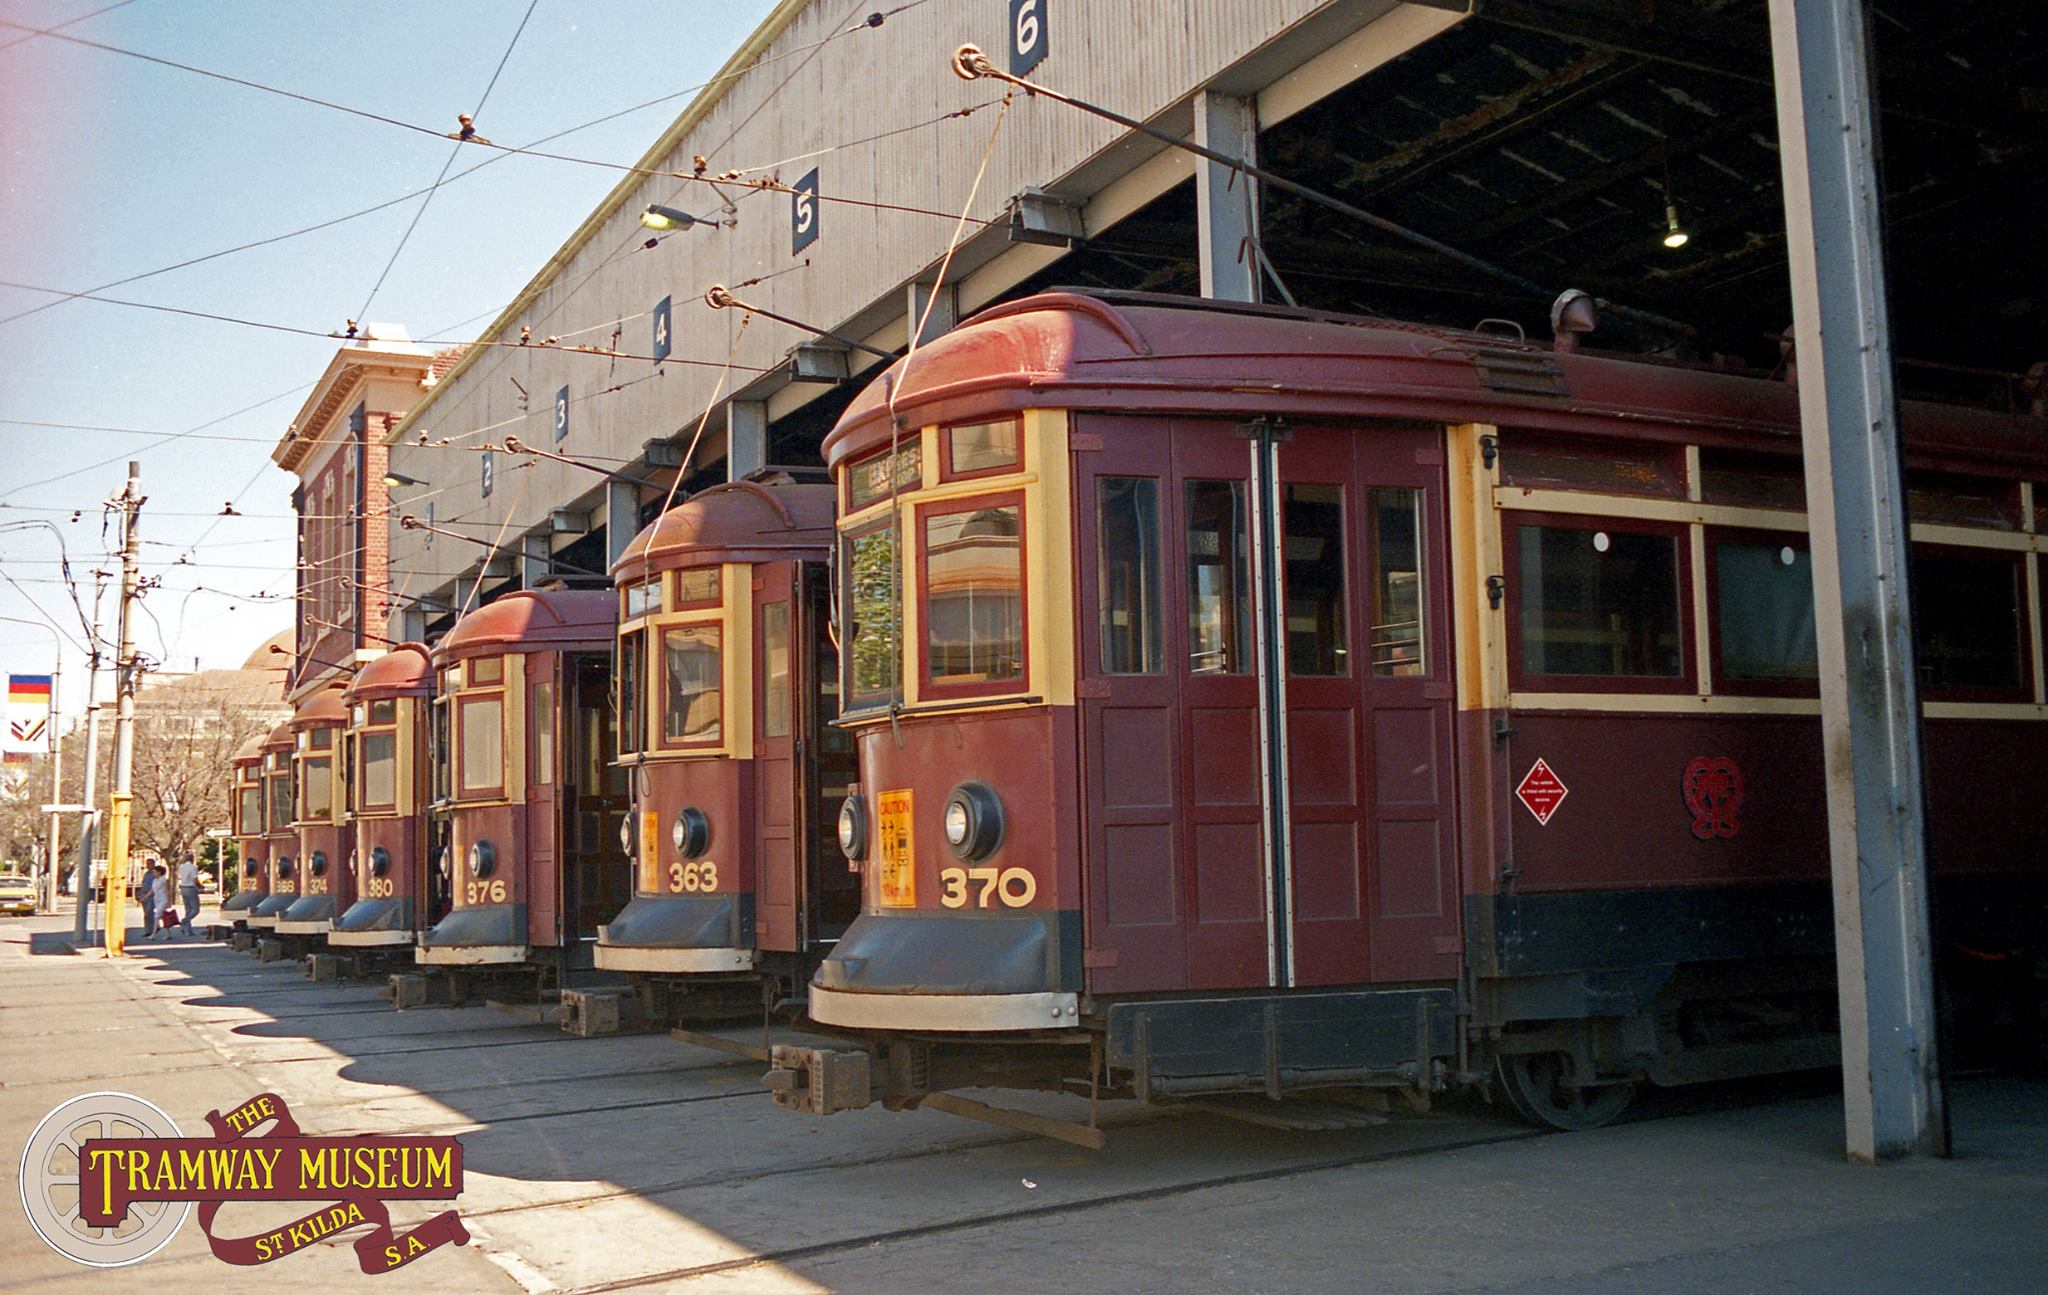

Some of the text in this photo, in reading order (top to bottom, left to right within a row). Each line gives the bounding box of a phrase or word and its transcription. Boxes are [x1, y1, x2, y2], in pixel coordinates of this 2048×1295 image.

[1016, 0, 1038, 55] 6
[797, 188, 813, 234] 5
[656, 313, 667, 346] 4
[556, 399, 566, 429] 3
[484, 462, 491, 487] 2
[880, 800, 909, 815] CAUTION
[276, 880, 295, 893] 368
[310, 878, 328, 894] 374
[369, 879, 393, 897] 380
[669, 861, 719, 893] 363
[940, 867, 1036, 909] 370
[467, 879, 506, 905] 376
